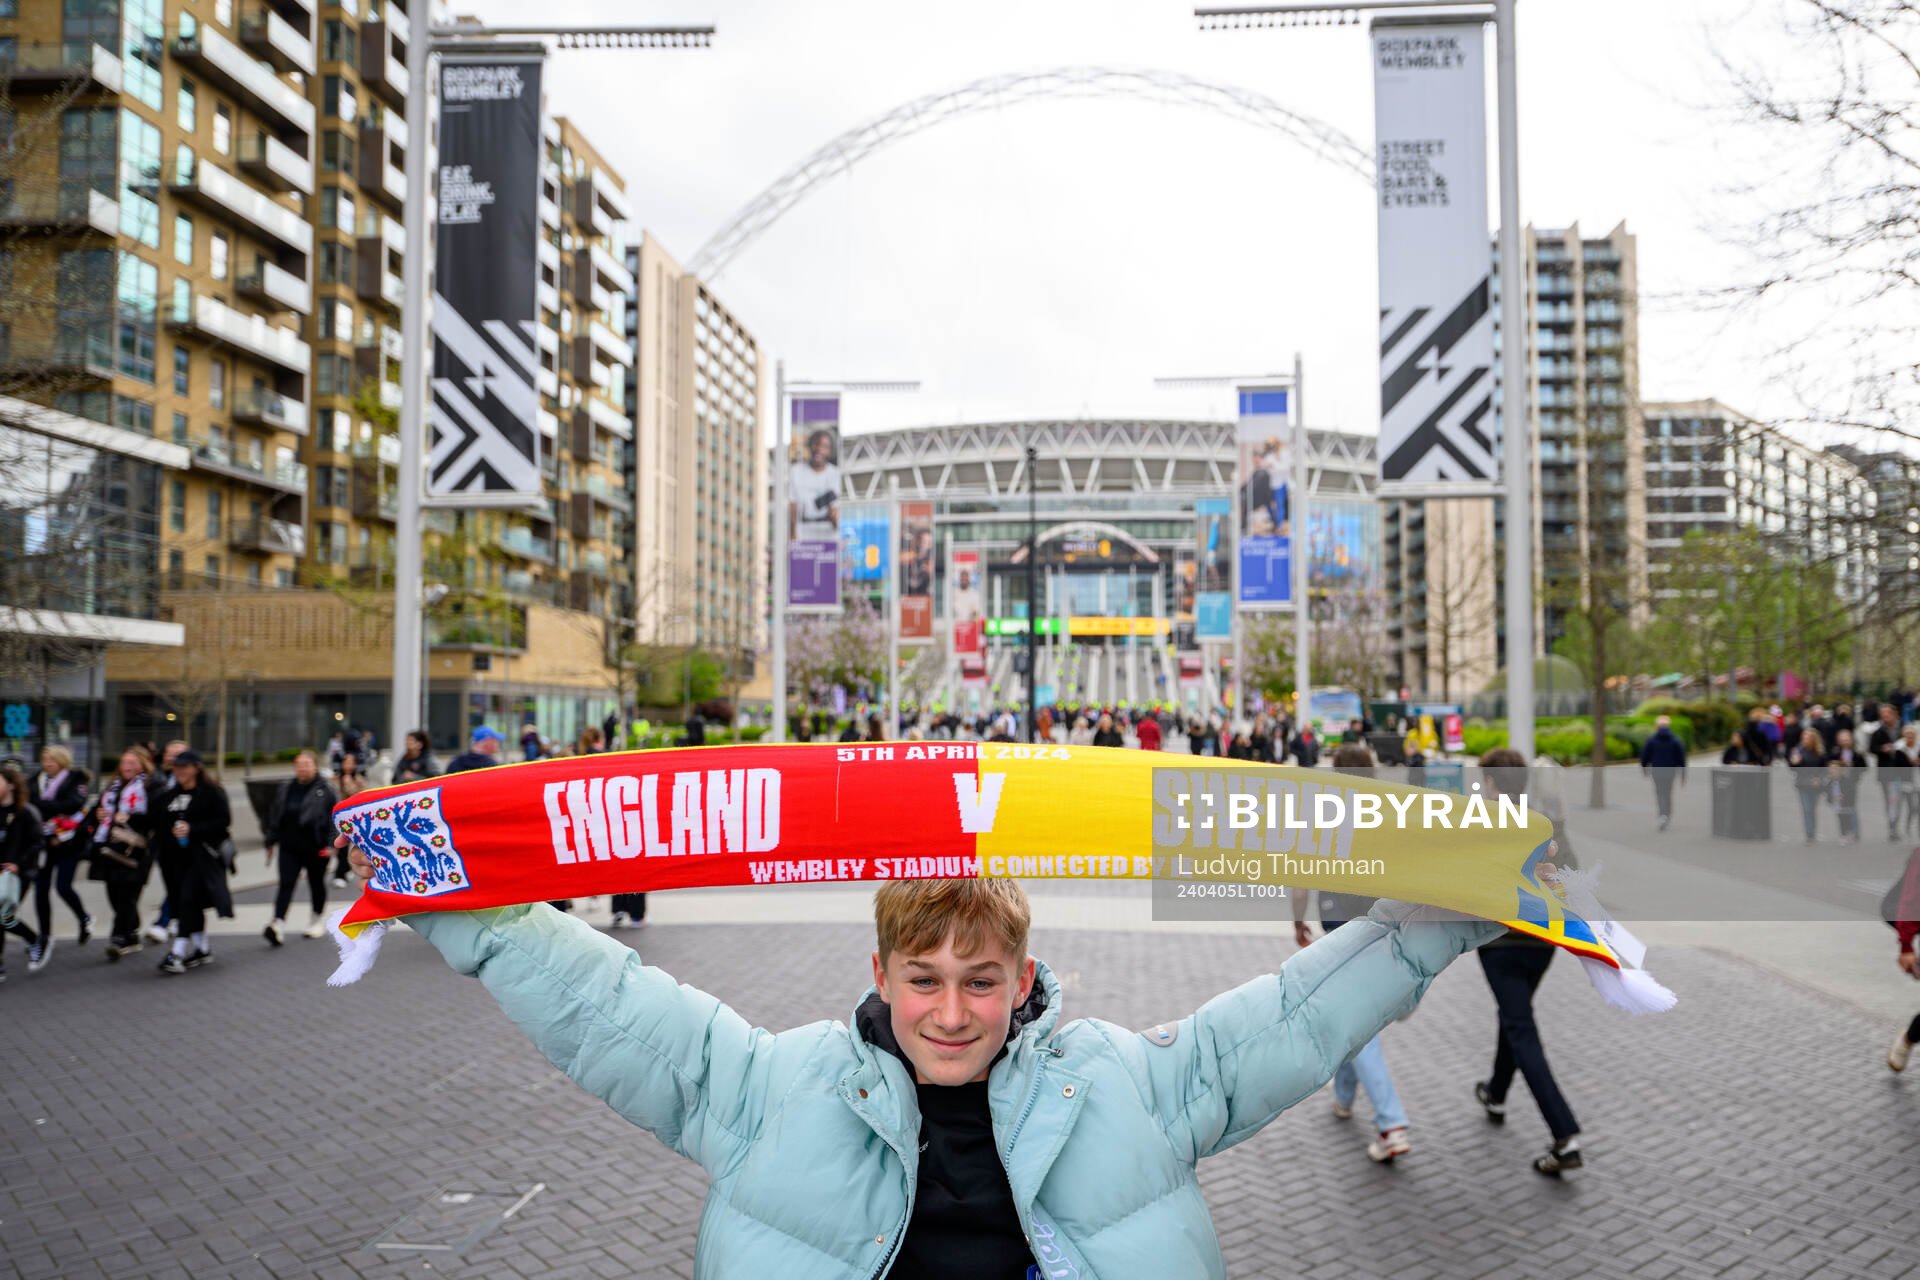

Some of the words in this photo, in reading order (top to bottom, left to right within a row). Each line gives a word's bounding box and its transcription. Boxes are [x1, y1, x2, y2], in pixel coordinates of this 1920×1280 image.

[1380, 54, 1465, 69] WEMBLEY
[443, 82, 524, 100] WEMBLEY
[1381, 139, 1445, 155] STREET
[1382, 191, 1450, 208] EVENTS
[837, 747, 894, 761] 5TH
[905, 745, 989, 760] APRIL
[995, 746, 1072, 761] 2024
[952, 773, 1006, 833] V
[543, 767, 782, 864] ENGLAND
[1153, 770, 1359, 859] SWEDEN
[749, 858, 866, 883] WEMBLEY
[874, 855, 984, 879] STADIUM
[989, 855, 1126, 877] CONNECTED
[1133, 856, 1165, 876] BY
